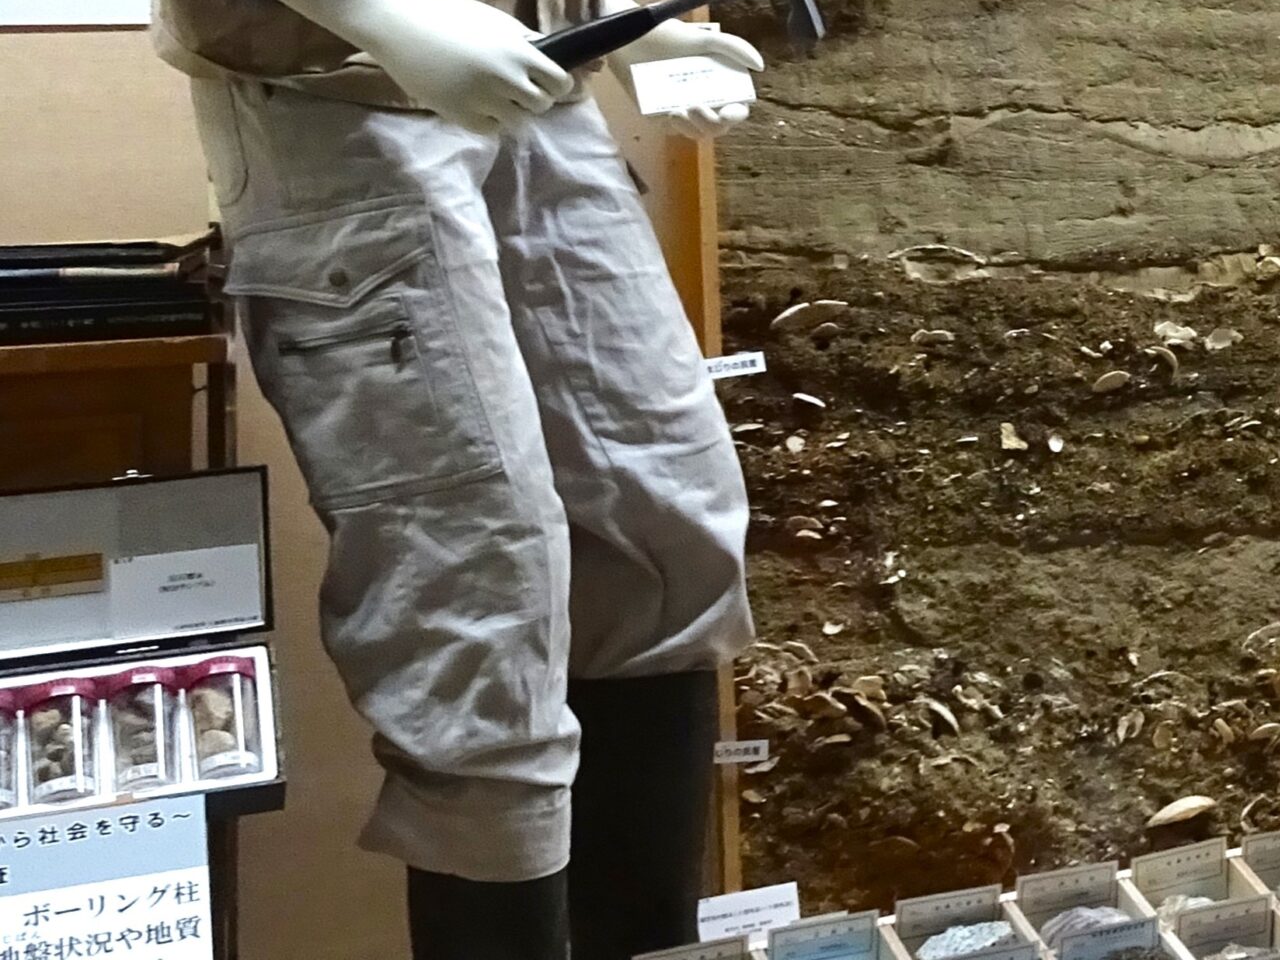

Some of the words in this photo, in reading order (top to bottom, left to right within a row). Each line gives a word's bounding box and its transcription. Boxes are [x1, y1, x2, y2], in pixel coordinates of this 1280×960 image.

[0, 811, 192, 848] ら社会を守る～
[23, 881, 201, 927] ボーリング柱
